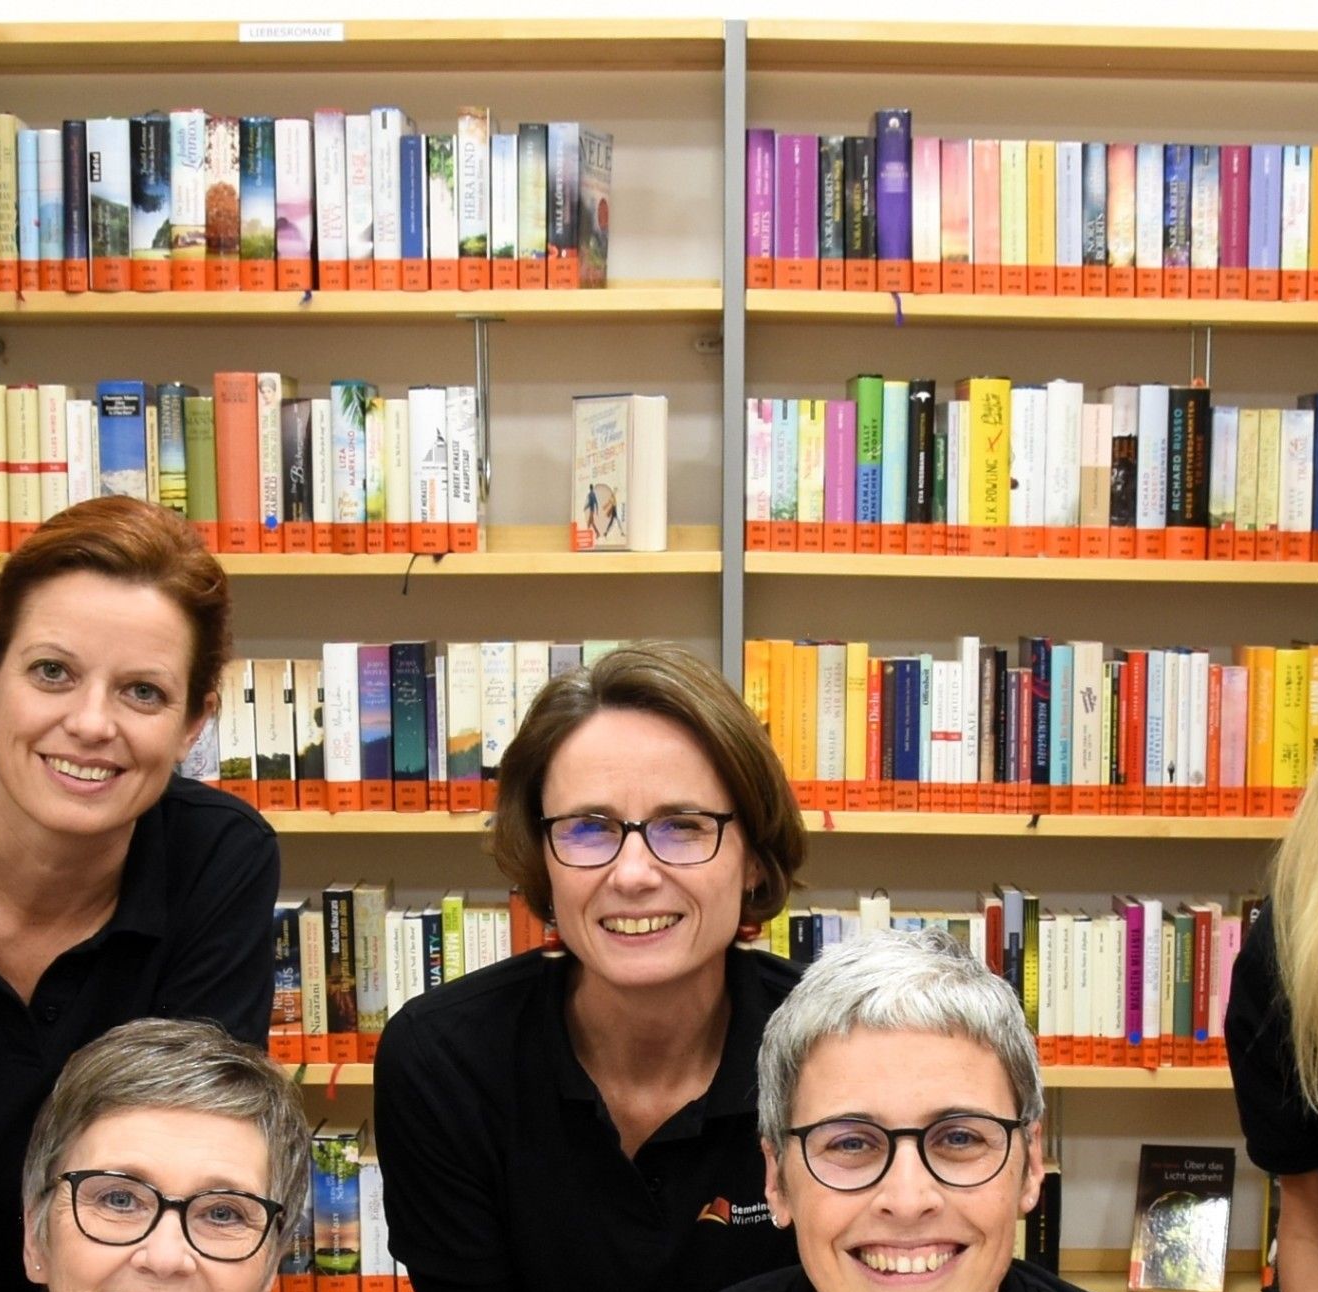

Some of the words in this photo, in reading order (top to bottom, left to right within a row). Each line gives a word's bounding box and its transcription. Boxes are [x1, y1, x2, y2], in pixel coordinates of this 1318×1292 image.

[249, 27, 333, 38] LIEBESROMANE
[181, 119, 203, 171] Lennox
[463, 141, 476, 177] LIND
[581, 134, 613, 170] NELE
[92, 153, 100, 180] PIPER
[463, 179, 476, 221] HERA
[825, 172, 833, 217] ROBERTS
[752, 212, 760, 237] NORA
[825, 220, 833, 248] NORA
[1086, 219, 1095, 253] NORA
[1095, 212, 1104, 260] ROBERTS
[1172, 408, 1183, 450] RUSSO
[339, 448, 347, 469] LIZA
[348, 430, 356, 486] MARKLUND
[452, 440, 460, 472] MENASSE
[462, 449, 470, 490] HAUPTSTADT
[452, 474, 460, 498] ROBERT
[463, 492, 471, 503] DIE
[985, 459, 998, 503] ROWLING
[1171, 455, 1181, 511] RICHARD
[824, 666, 832, 715] SOLANGE
[922, 668, 930, 706] Offenheit
[869, 692, 880, 722] Dicht
[967, 710, 976, 757] STRAFE
[329, 900, 339, 928] Niavarani
[330, 928, 340, 953] Michael
[283, 967, 295, 1022] NEUHAUS
[309, 983, 321, 1033] Niavarani
[1164, 1170, 1186, 1181] Licht
[1187, 1170, 1224, 1183] gedreht
[1183, 1159, 1206, 1170] Über
[1208, 1160, 1224, 1171] das
[731, 1202, 771, 1215] Gemein
